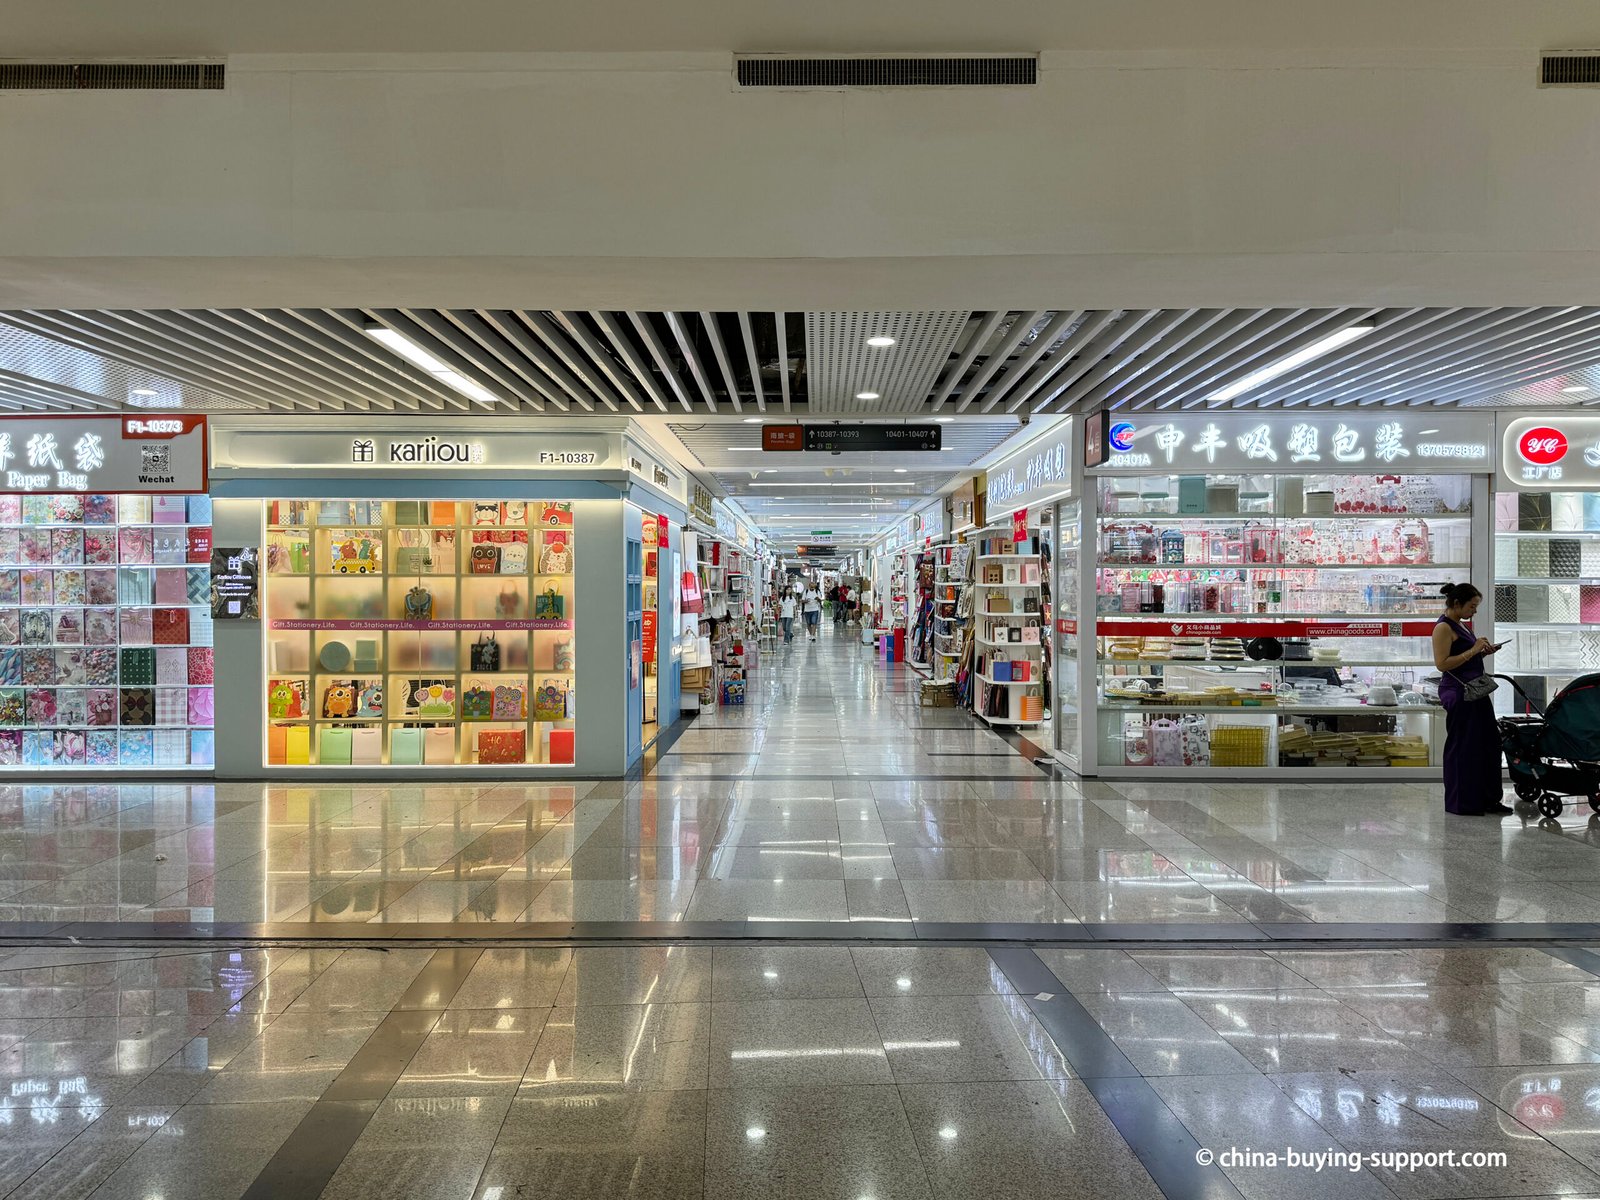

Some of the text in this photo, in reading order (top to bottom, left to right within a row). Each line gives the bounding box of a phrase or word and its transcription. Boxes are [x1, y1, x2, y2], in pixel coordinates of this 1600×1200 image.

[127, 420, 183, 433] F1-10373
[816, 430, 859, 438] 10387-10393
[885, 430, 929, 438] 10401-10407
[1155, 422, 1410, 463] 申丰吸塑包装
[1416, 443, 1486, 457] 13705798121
[539, 452, 595, 464] F1-10387
[7, 471, 88, 491] Paper Bag
[138, 475, 175, 483] Wechat
